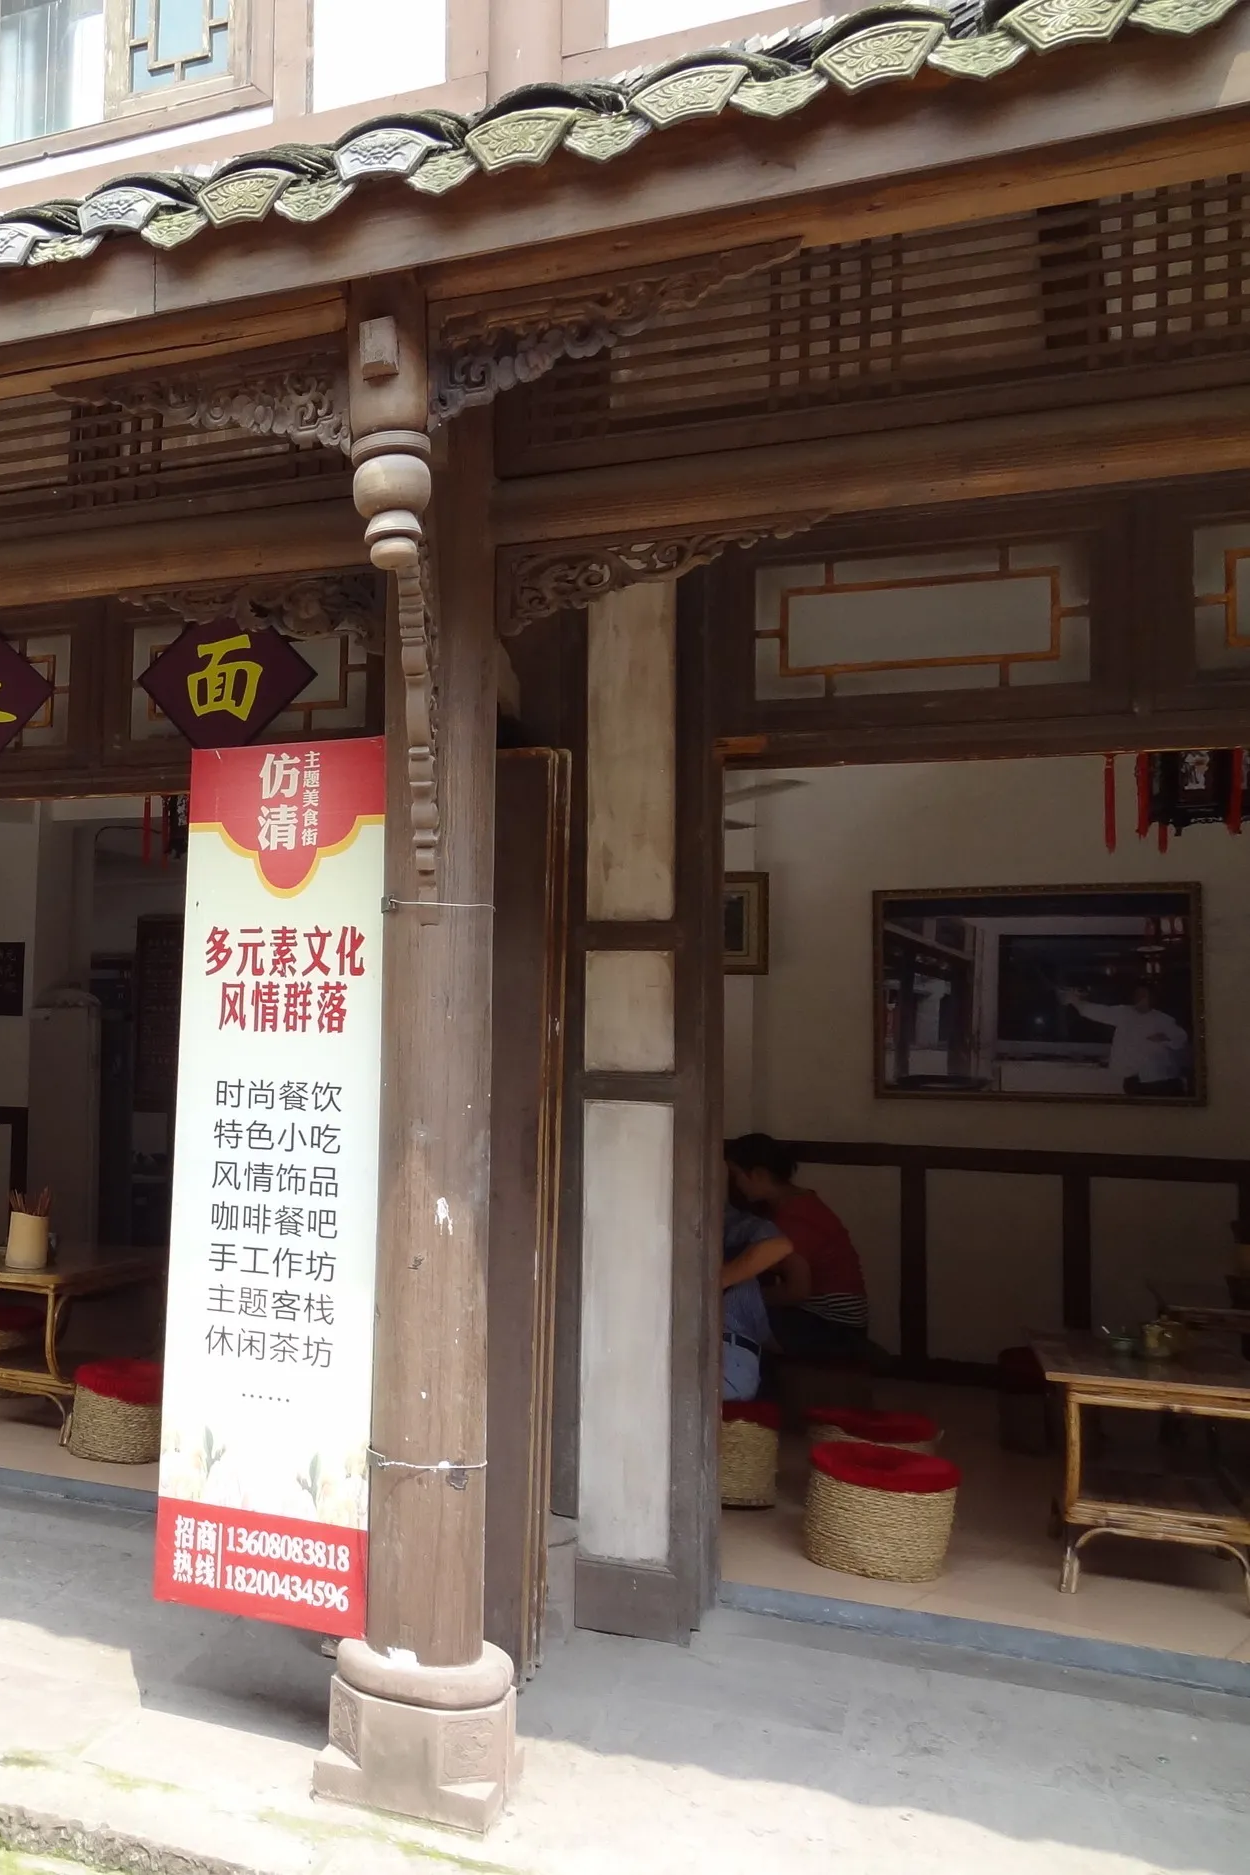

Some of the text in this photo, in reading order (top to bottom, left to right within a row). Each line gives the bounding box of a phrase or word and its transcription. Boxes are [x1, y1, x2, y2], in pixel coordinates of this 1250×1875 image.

[258, 752, 301, 851] 仿清
[302, 750, 321, 846] 主题美食街
[205, 925, 366, 978] 多元素文化
[218, 981, 348, 1034] 风情群落
[215, 1079, 343, 1113] 时尚餐饮
[213, 1119, 341, 1155] 特色小吃
[211, 1161, 340, 1198] 风情饰品
[210, 1201, 338, 1239] 咖啡餐吧
[208, 1243, 336, 1282] 手工作坊
[206, 1284, 334, 1326] 主题客栈
[204, 1325, 334, 1369] 休闲茶坊
[174, 1514, 218, 1553] 招商
[225, 1525, 350, 1572] 13608083818
[173, 1548, 216, 1588] 热线
[224, 1562, 349, 1612] 18200434596
